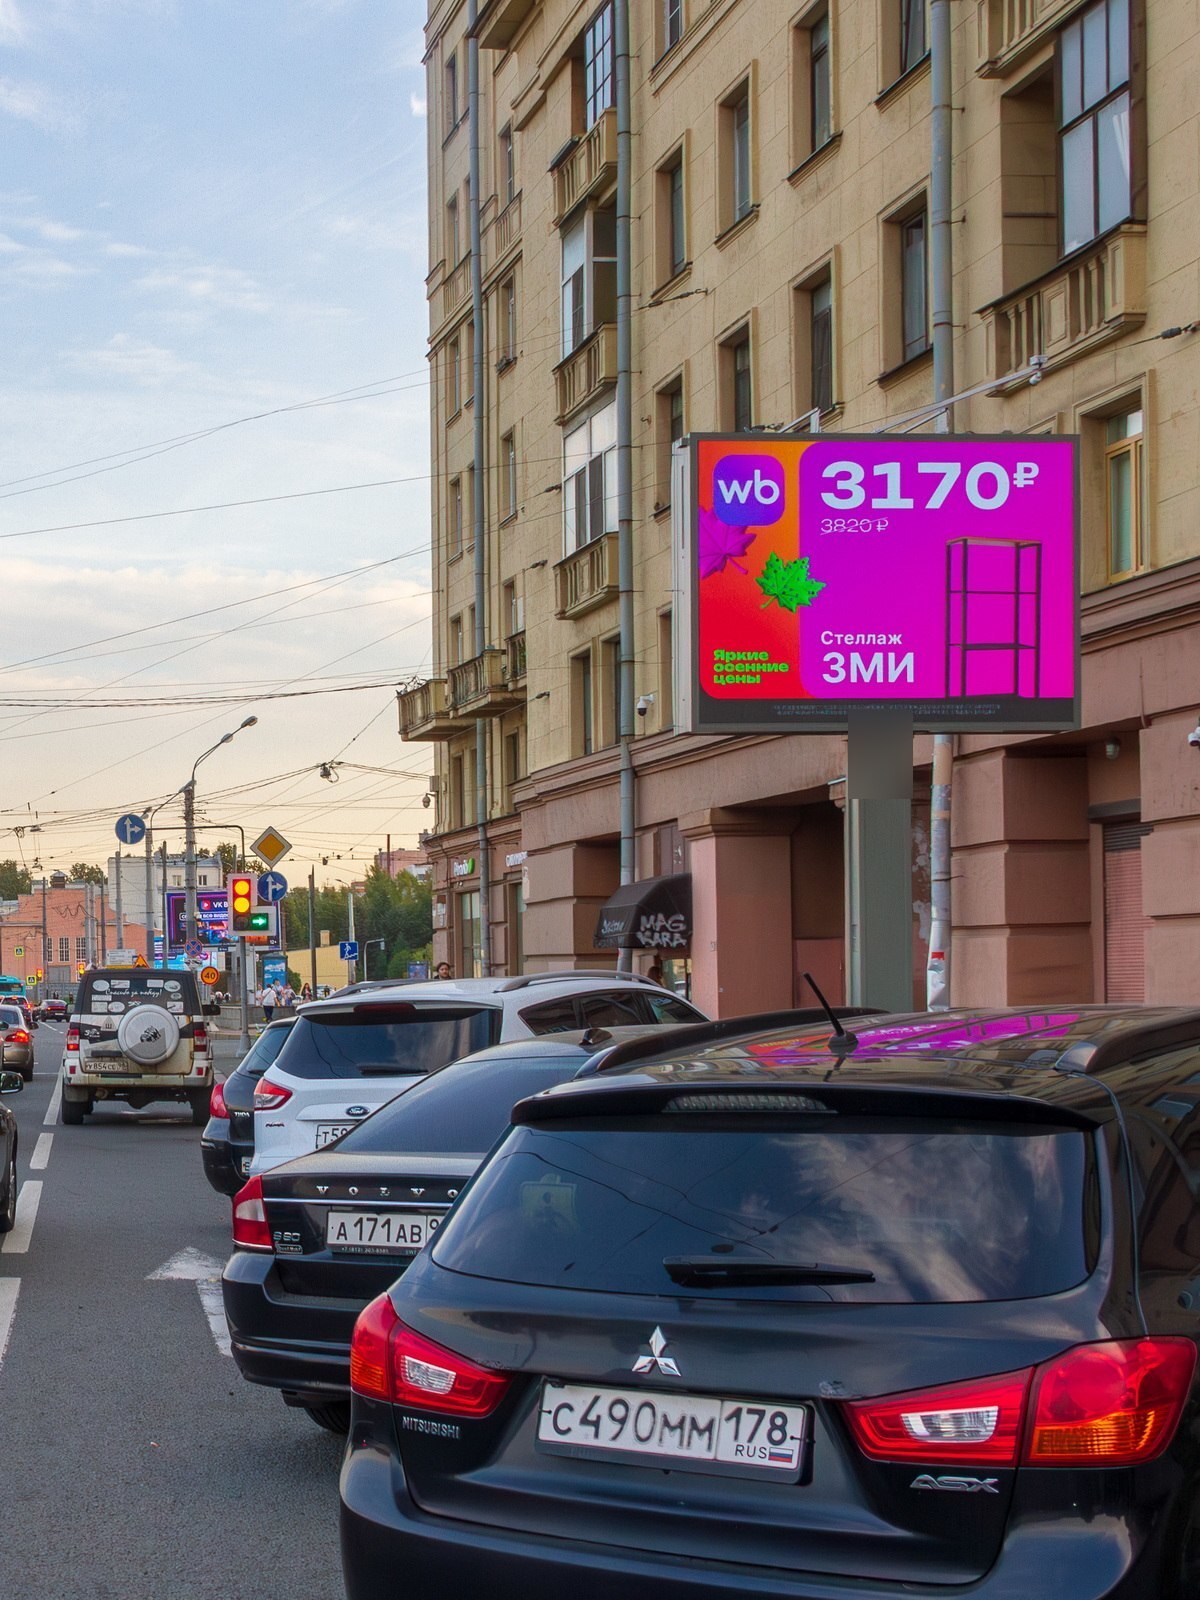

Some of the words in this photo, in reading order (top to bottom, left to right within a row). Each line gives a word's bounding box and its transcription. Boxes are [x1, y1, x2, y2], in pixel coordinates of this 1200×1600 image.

[718, 469, 780, 505] wb
[820, 630, 902, 646] Стеллаж
[713, 649, 770, 663] Яркие
[713, 662, 790, 673] осенние
[822, 651, 915, 684] ЗМИ
[713, 674, 762, 686] цены
[640, 913, 687, 932] MAG
[204, 971, 216, 980] 40
[316, 1185, 459, 1198] VOLVO
[402, 1415, 460, 1439] MITSUBISHI
[552, 1395, 716, 1453] С490ММ
[724, 1406, 789, 1446] 178
[734, 1443, 768, 1459] RUS
[909, 1474, 1000, 1494] ASX
